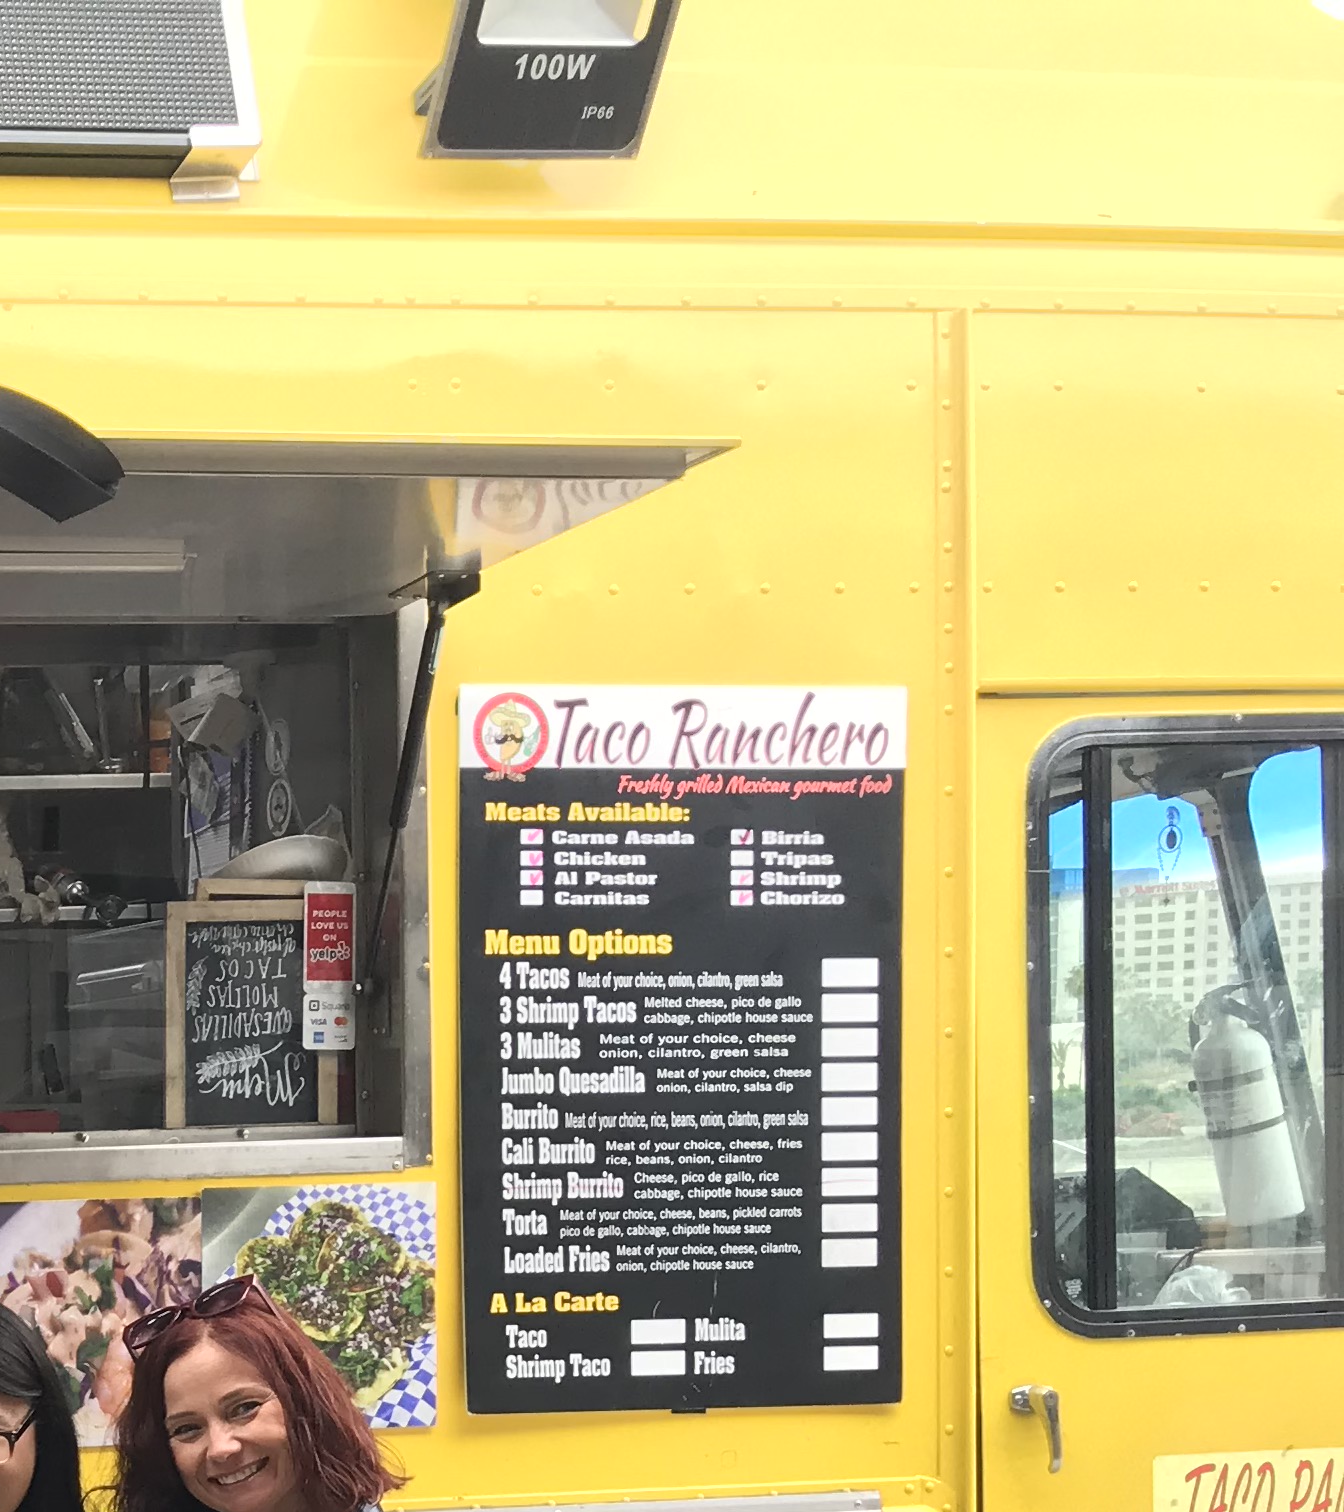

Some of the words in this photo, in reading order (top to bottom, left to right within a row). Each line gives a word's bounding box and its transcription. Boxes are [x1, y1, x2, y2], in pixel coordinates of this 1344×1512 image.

[514, 53, 596, 81] 100W
[581, 105, 615, 120] IP66
[553, 699, 652, 769] Taco
[671, 692, 890, 770] Ranchero
[618, 774, 673, 799] Freshly
[676, 775, 723, 799] grilled
[725, 774, 789, 795] Mexican
[790, 779, 857, 799] gourmet
[860, 774, 894, 795] food
[485, 802, 560, 821] Meats
[568, 802, 690, 822] Available:
[552, 830, 618, 844] Carne
[625, 830, 694, 844] Asada
[762, 831, 824, 845] Birria
[554, 852, 646, 865] Chicken
[761, 852, 834, 868] Tripas
[555, 872, 578, 885] Al
[585, 872, 657, 885] Pastor
[760, 872, 842, 888] Shrimp
[555, 891, 649, 905] Carnitas
[760, 891, 844, 905] Chorizo
[312, 910, 347, 918] PEOPLE
[311, 922, 334, 930] LOVE
[336, 922, 349, 930] US
[485, 929, 560, 955] Menu
[569, 928, 672, 960] Options
[310, 949, 338, 962] yelp
[216, 958, 287, 982] TACOS
[500, 962, 511, 989] 4
[516, 962, 570, 989] Tacos
[645, 997, 682, 1008] Melted
[732, 996, 754, 1009] pico
[758, 996, 772, 1007] de
[775, 996, 802, 1009] gallo
[500, 996, 511, 1024] 3
[516, 996, 579, 1030] Shrimp
[584, 996, 636, 1023] Tacos
[698, 1012, 742, 1025] chipotle
[746, 1012, 778, 1023] house
[781, 1014, 813, 1022] sauce
[310, 1018, 327, 1026] VISA
[501, 1032, 512, 1059] 3
[518, 1032, 580, 1059] Mulitas
[600, 1034, 635, 1044] Meat
[640, 1033, 653, 1044] of
[658, 1035, 689, 1046] your
[748, 1033, 796, 1043] cheese
[710, 1049, 748, 1059] green
[754, 1047, 788, 1056] salsa
[501, 1067, 554, 1094] Jumbo
[559, 1066, 645, 1096] Quesadilla
[657, 1068, 684, 1078] Meat
[688, 1068, 699, 1078] of
[702, 1070, 727, 1080] your
[774, 1068, 812, 1077] cheese
[744, 1082, 772, 1092] salsa
[776, 1081, 793, 1093] dip
[502, 1102, 558, 1129] Burrito
[502, 1137, 534, 1165] Cali
[539, 1137, 595, 1164] Burrito
[606, 1141, 635, 1151] Meat
[639, 1140, 650, 1150] of
[654, 1142, 680, 1152] your
[778, 1138, 802, 1148] fries
[718, 1153, 762, 1163] cilantro
[682, 1172, 705, 1185] pico
[708, 1172, 722, 1182] de
[759, 1170, 779, 1181] rice
[502, 1172, 562, 1206] Shrimp
[567, 1171, 623, 1198] Burrito
[688, 1187, 732, 1200] chipotle
[735, 1187, 768, 1197] house
[771, 1188, 802, 1197] sauce
[502, 1208, 547, 1235] Torta
[617, 1245, 641, 1256] Meat
[644, 1244, 654, 1256] of
[657, 1246, 679, 1257] your
[504, 1246, 564, 1273] Loaded
[569, 1245, 610, 1272] Fries
[650, 1257, 690, 1273] chipotle
[693, 1259, 722, 1270] house
[725, 1260, 754, 1269] sauce
[490, 1293, 508, 1313] A
[516, 1293, 546, 1312] La
[554, 1292, 619, 1312] Carte
[506, 1325, 547, 1348] Taco
[695, 1318, 745, 1341] Mulita
[506, 1354, 565, 1383] Shrimp
[570, 1354, 610, 1376] Taco
[694, 1351, 734, 1374] Fries
